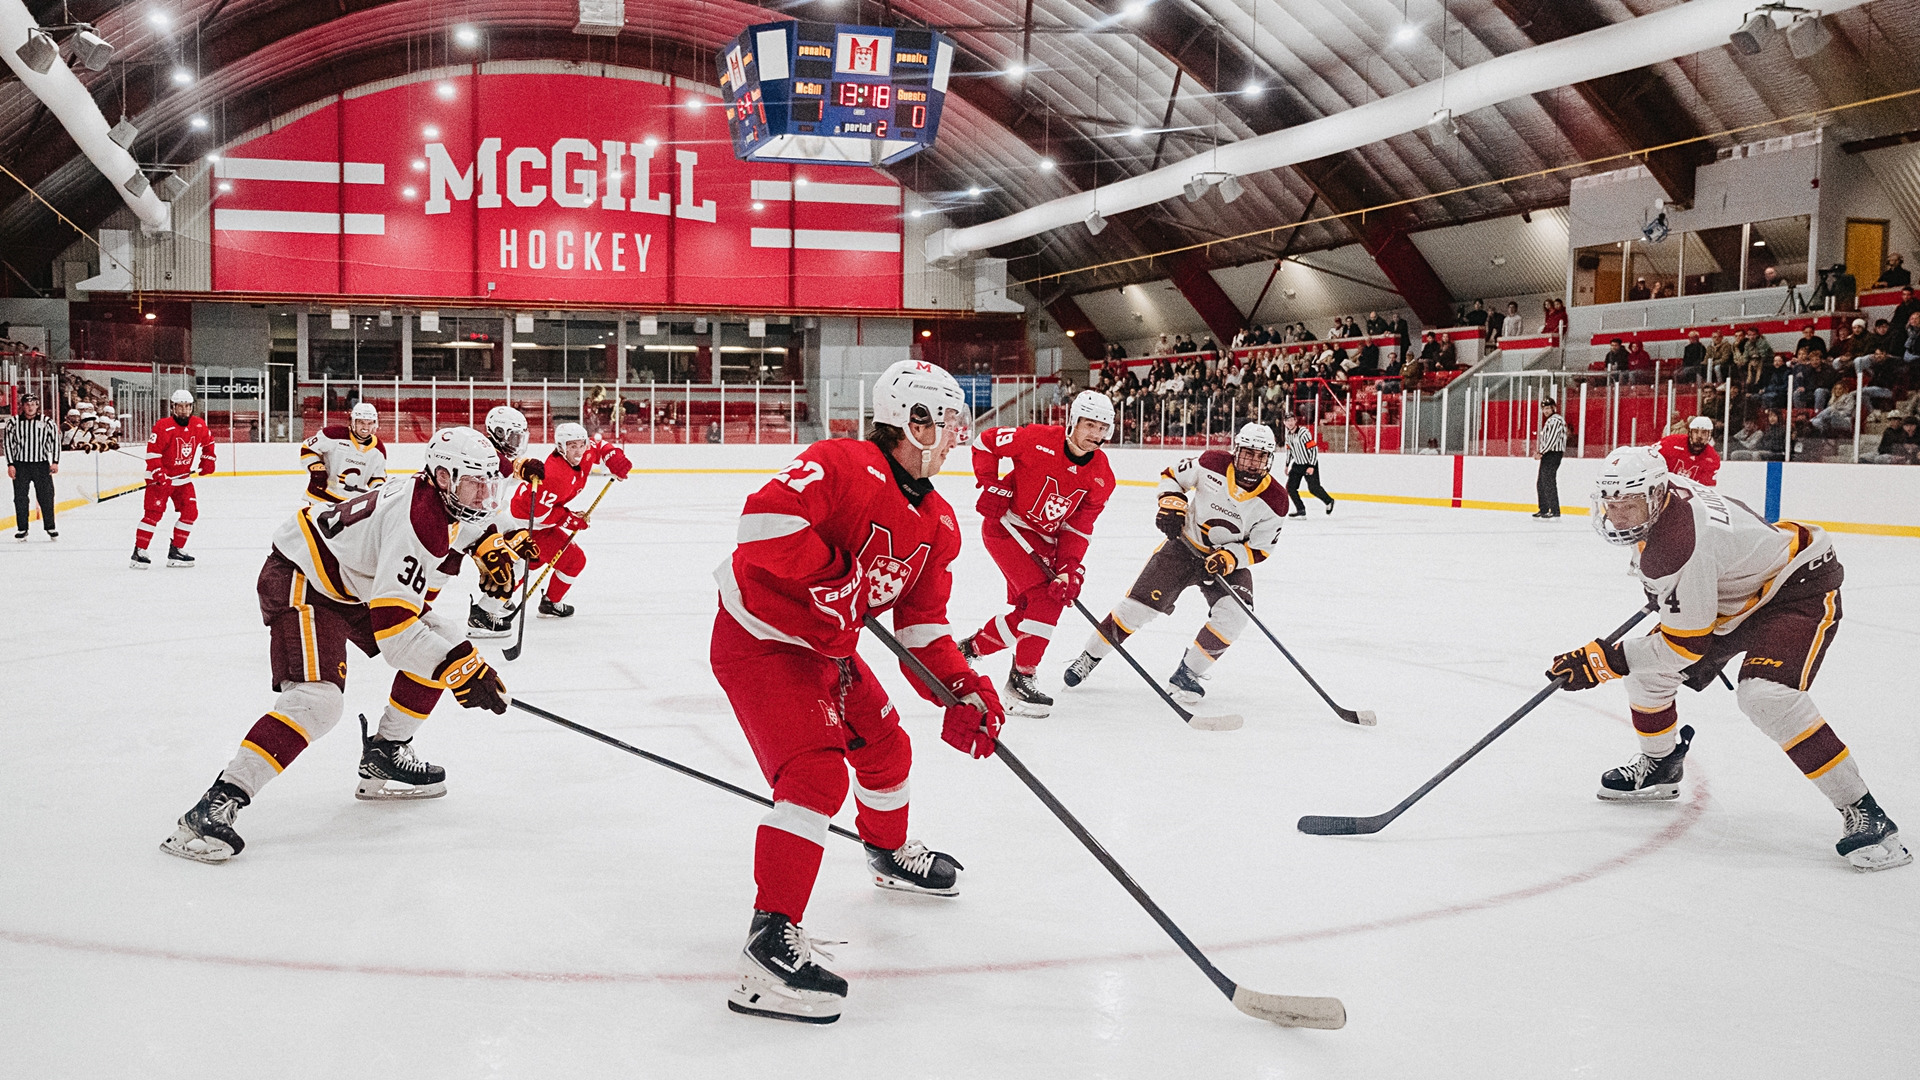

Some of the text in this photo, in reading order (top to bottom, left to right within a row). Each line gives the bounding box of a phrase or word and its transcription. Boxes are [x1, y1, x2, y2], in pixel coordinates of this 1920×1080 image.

[798, 45, 831, 59] penalty
[896, 52, 928, 66] penalty
[795, 82, 822, 95] McGill
[839, 83, 891, 109] 13:18
[897, 88, 927, 102] Guests
[912, 105, 926, 128] 0
[844, 120, 888, 138] period 2
[500, 229, 651, 272] HOCKEY
[916, 361, 932, 374] M
[222, 383, 264, 394] adidas
[996, 427, 1016, 447] 19
[1612, 458, 1620, 466] 4
[1207, 474, 1223, 486] OUA
[539, 490, 558, 508] 12
[987, 485, 1013, 498] BAU
[1210, 503, 1242, 520] CONCORD
[1809, 547, 1836, 570] CC
[397, 555, 427, 594] 38
[1664, 588, 1680, 613] 4
[1743, 657, 1783, 668] CCM
